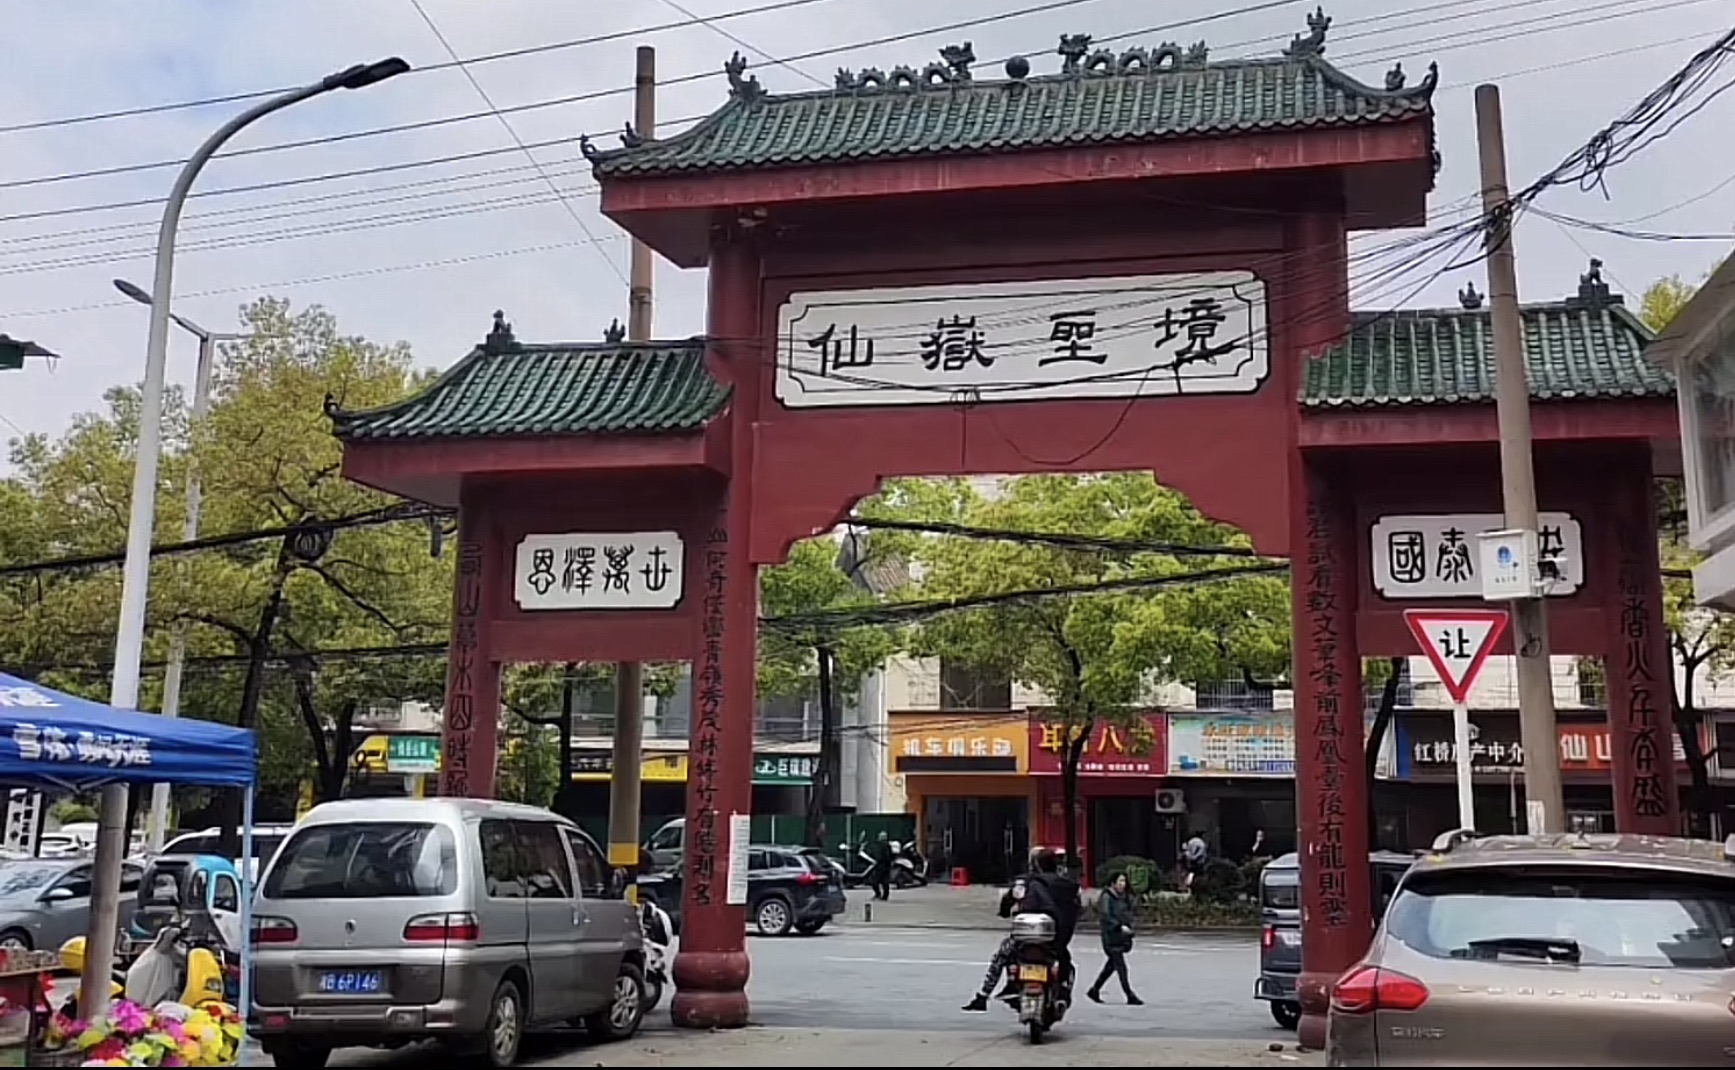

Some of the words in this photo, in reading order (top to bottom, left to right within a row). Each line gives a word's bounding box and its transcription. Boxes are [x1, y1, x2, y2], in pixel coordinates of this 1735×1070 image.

[807, 298, 1227, 378] 仙嶽聖境
[1387, 526, 1567, 584] 國泰安
[1438, 628, 1472, 660] 让
[1414, 741, 1525, 764] 红桥产中介
